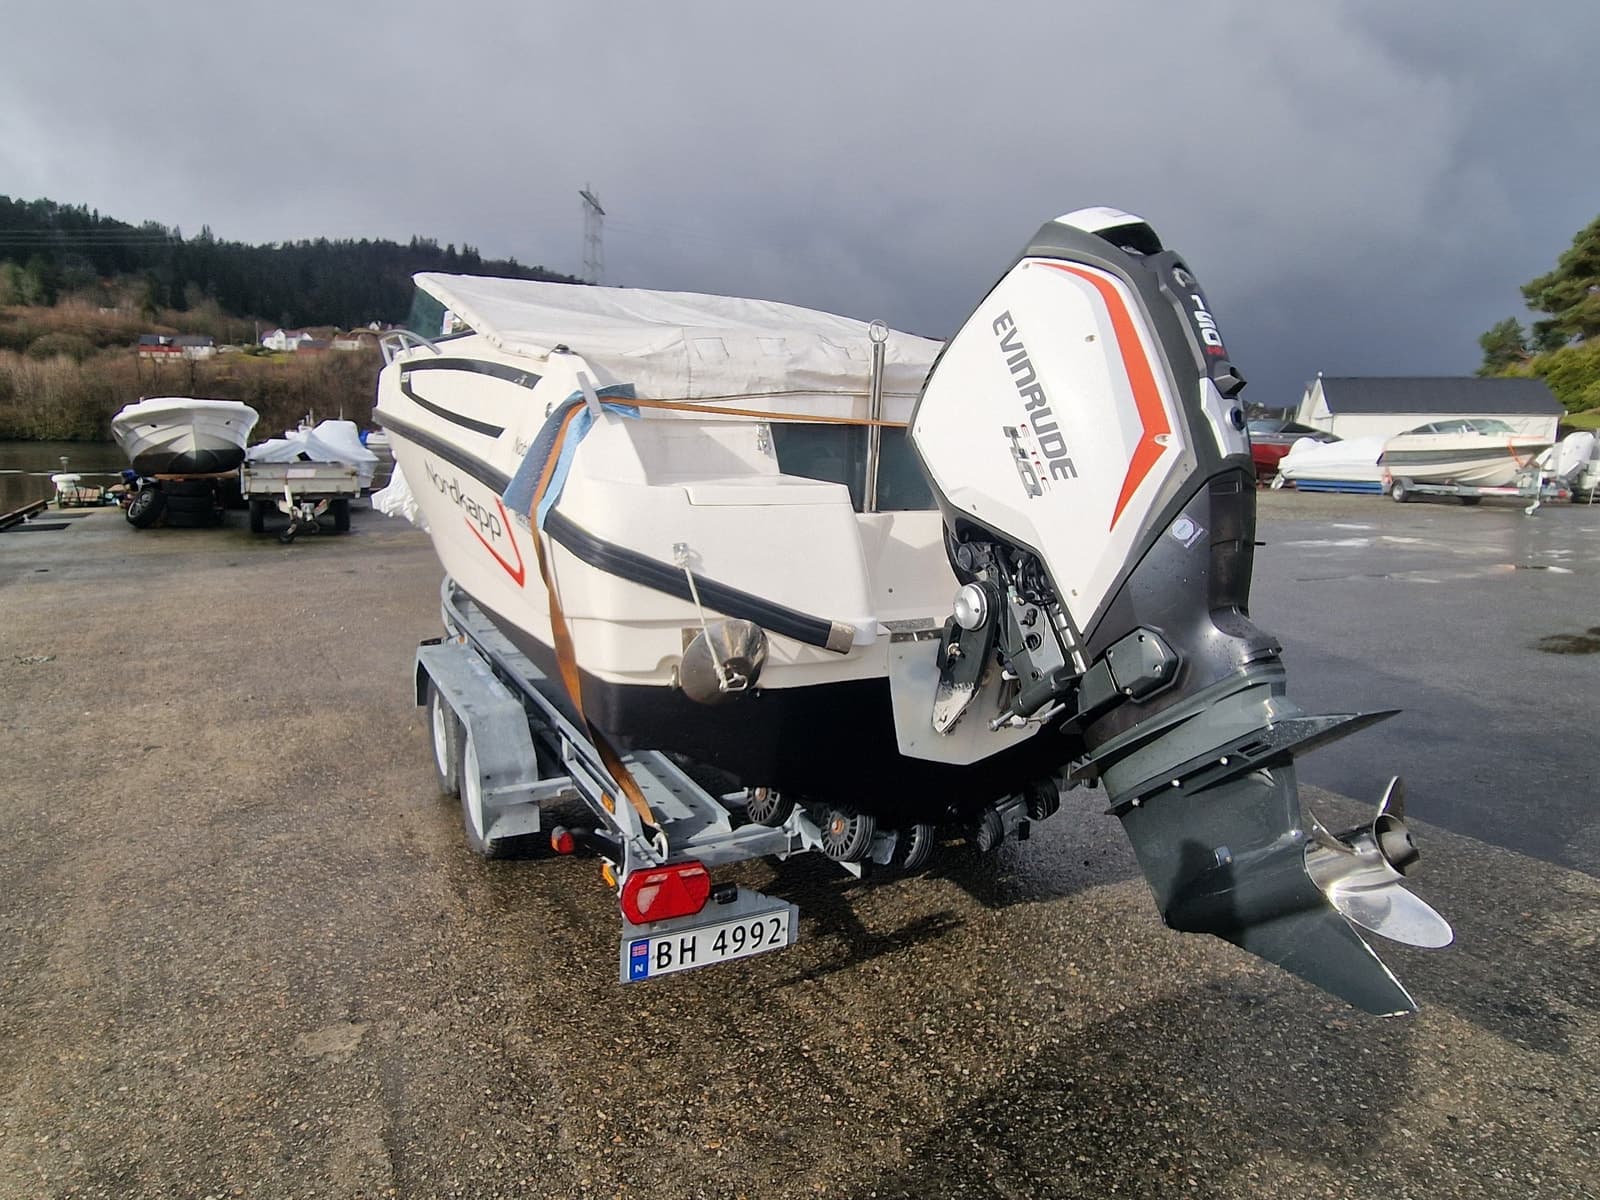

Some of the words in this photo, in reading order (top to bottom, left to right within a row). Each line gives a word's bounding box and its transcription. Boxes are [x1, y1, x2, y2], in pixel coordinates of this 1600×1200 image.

[992, 309, 1078, 481] EVINRUDE
[425, 459, 502, 540] Nordkapp
[635, 963, 644, 973] N
[656, 936, 696, 969] BH
[712, 917, 781, 956] 4992
